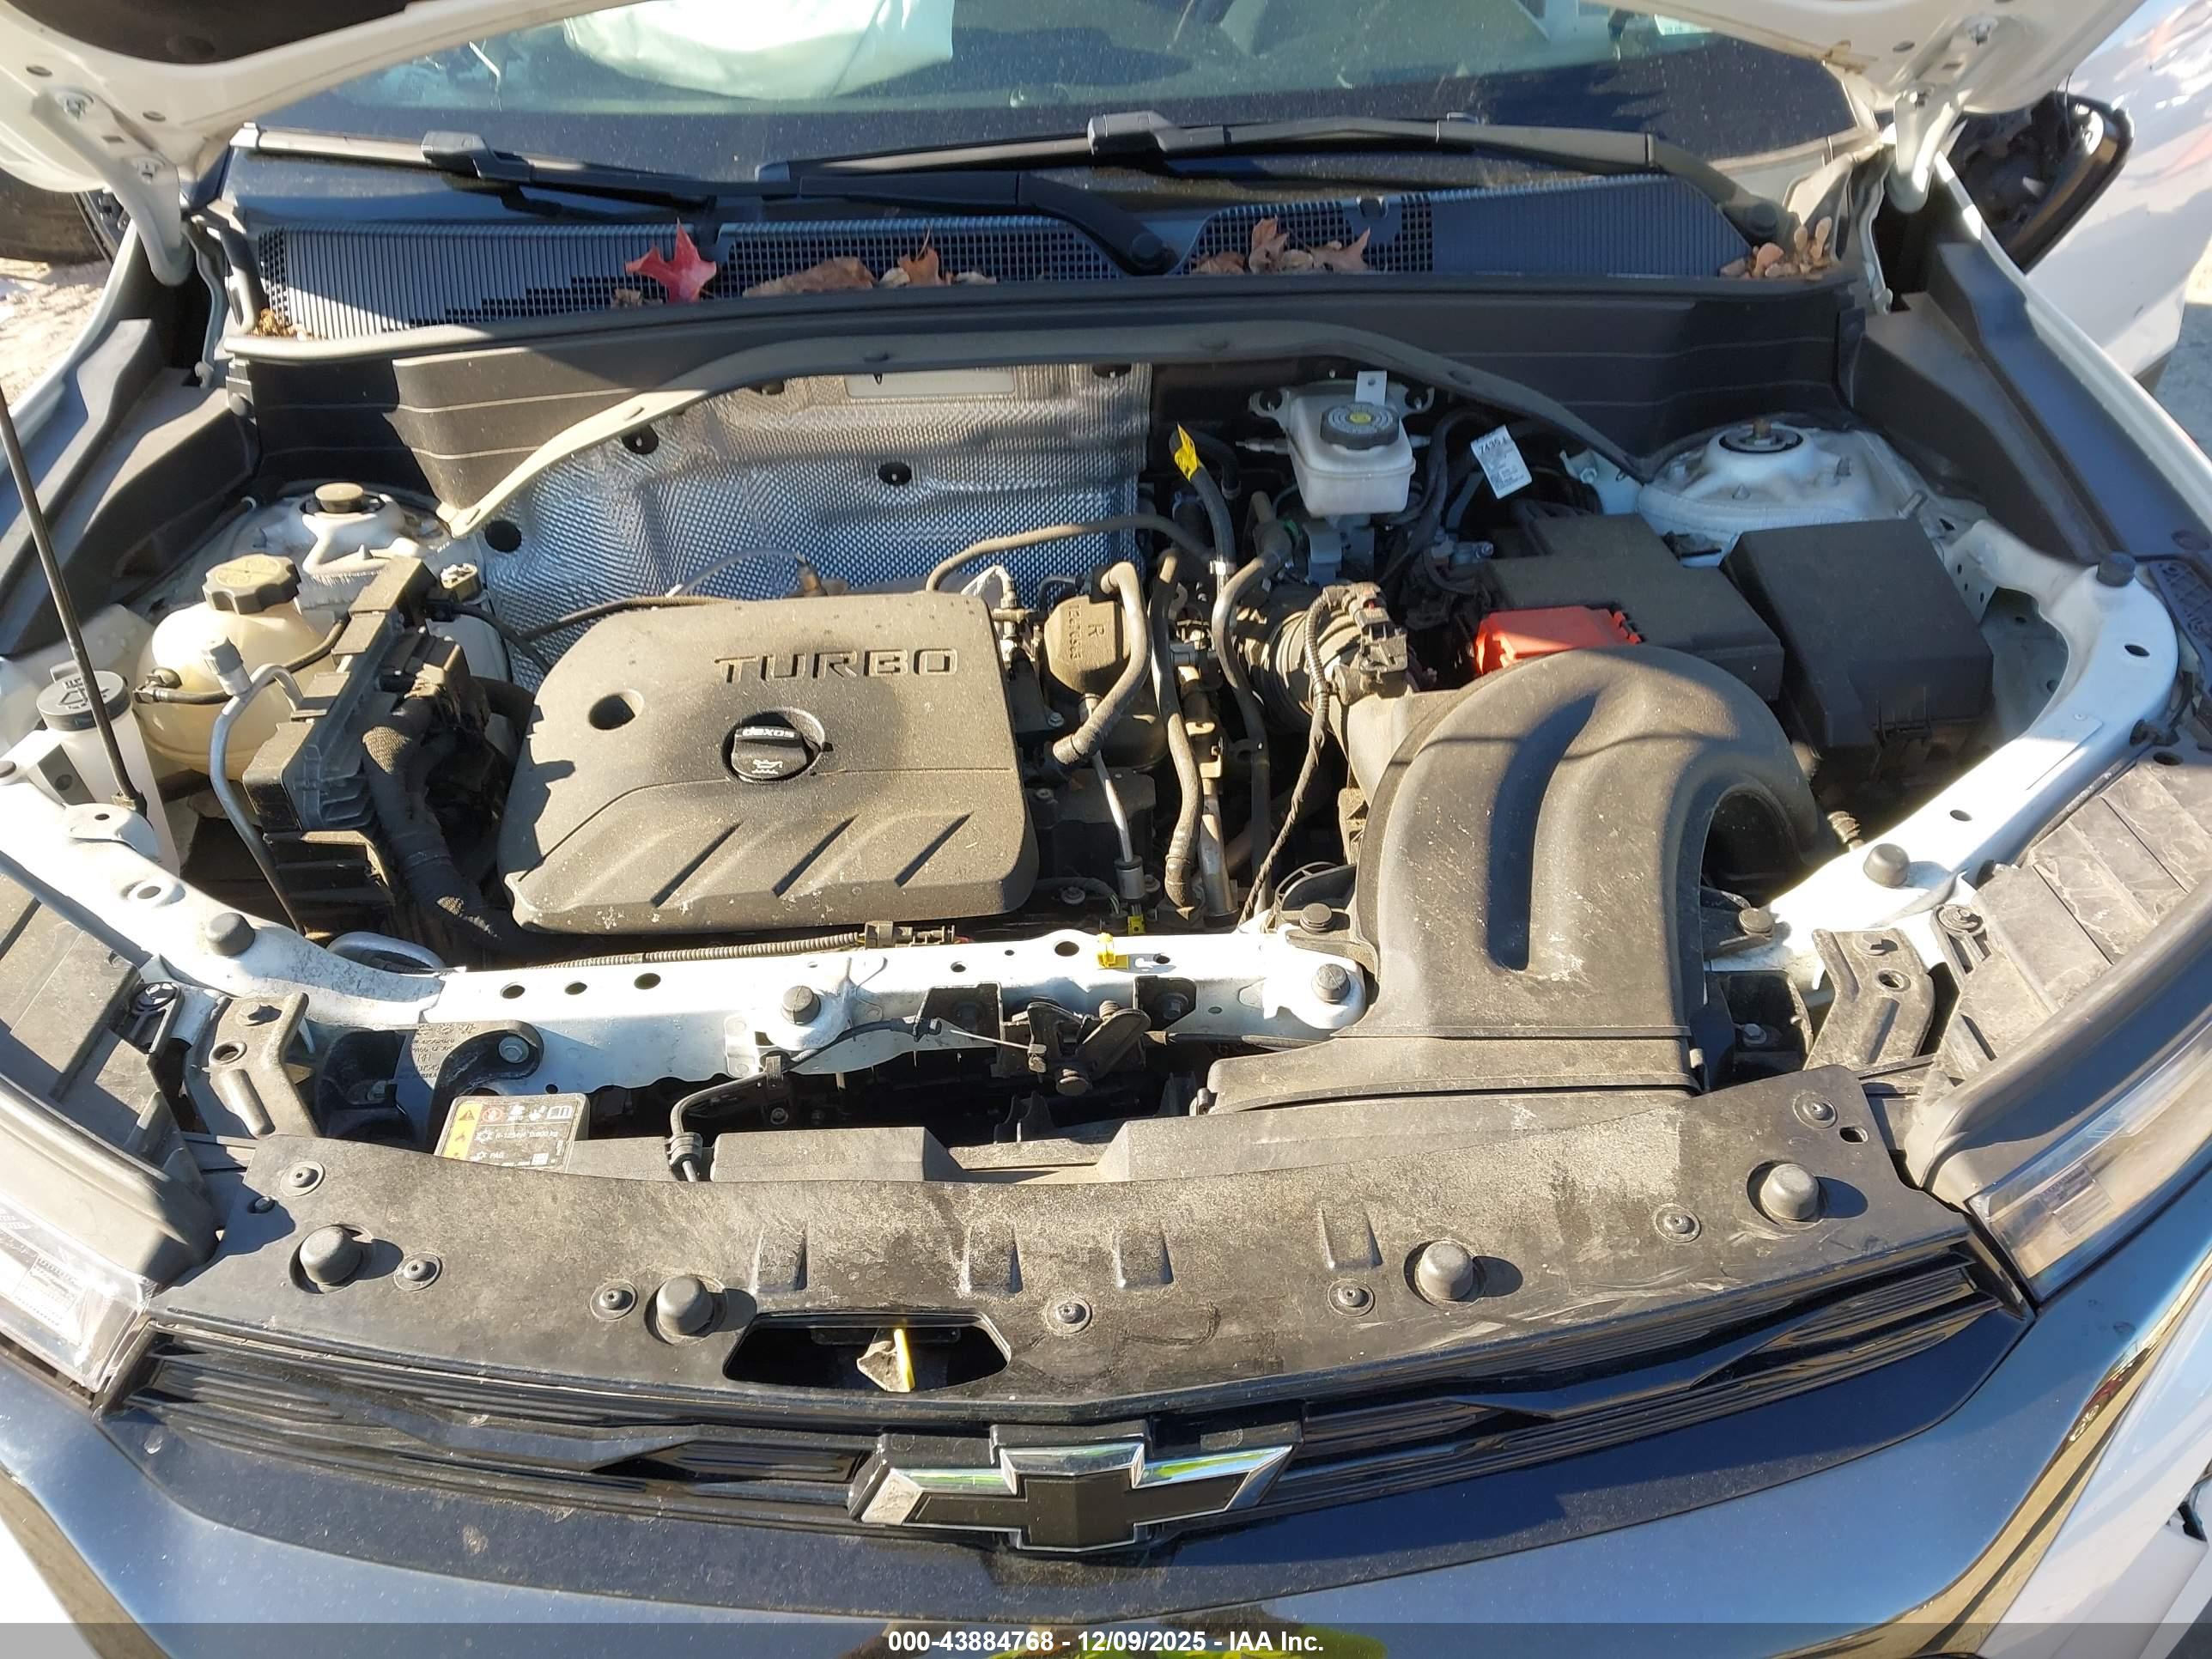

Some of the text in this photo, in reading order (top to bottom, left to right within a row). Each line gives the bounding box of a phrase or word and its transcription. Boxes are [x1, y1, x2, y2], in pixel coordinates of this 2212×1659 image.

[1087, 624, 1105, 637] R
[714, 648, 958, 684] TURBO
[742, 726, 795, 738] dexos
